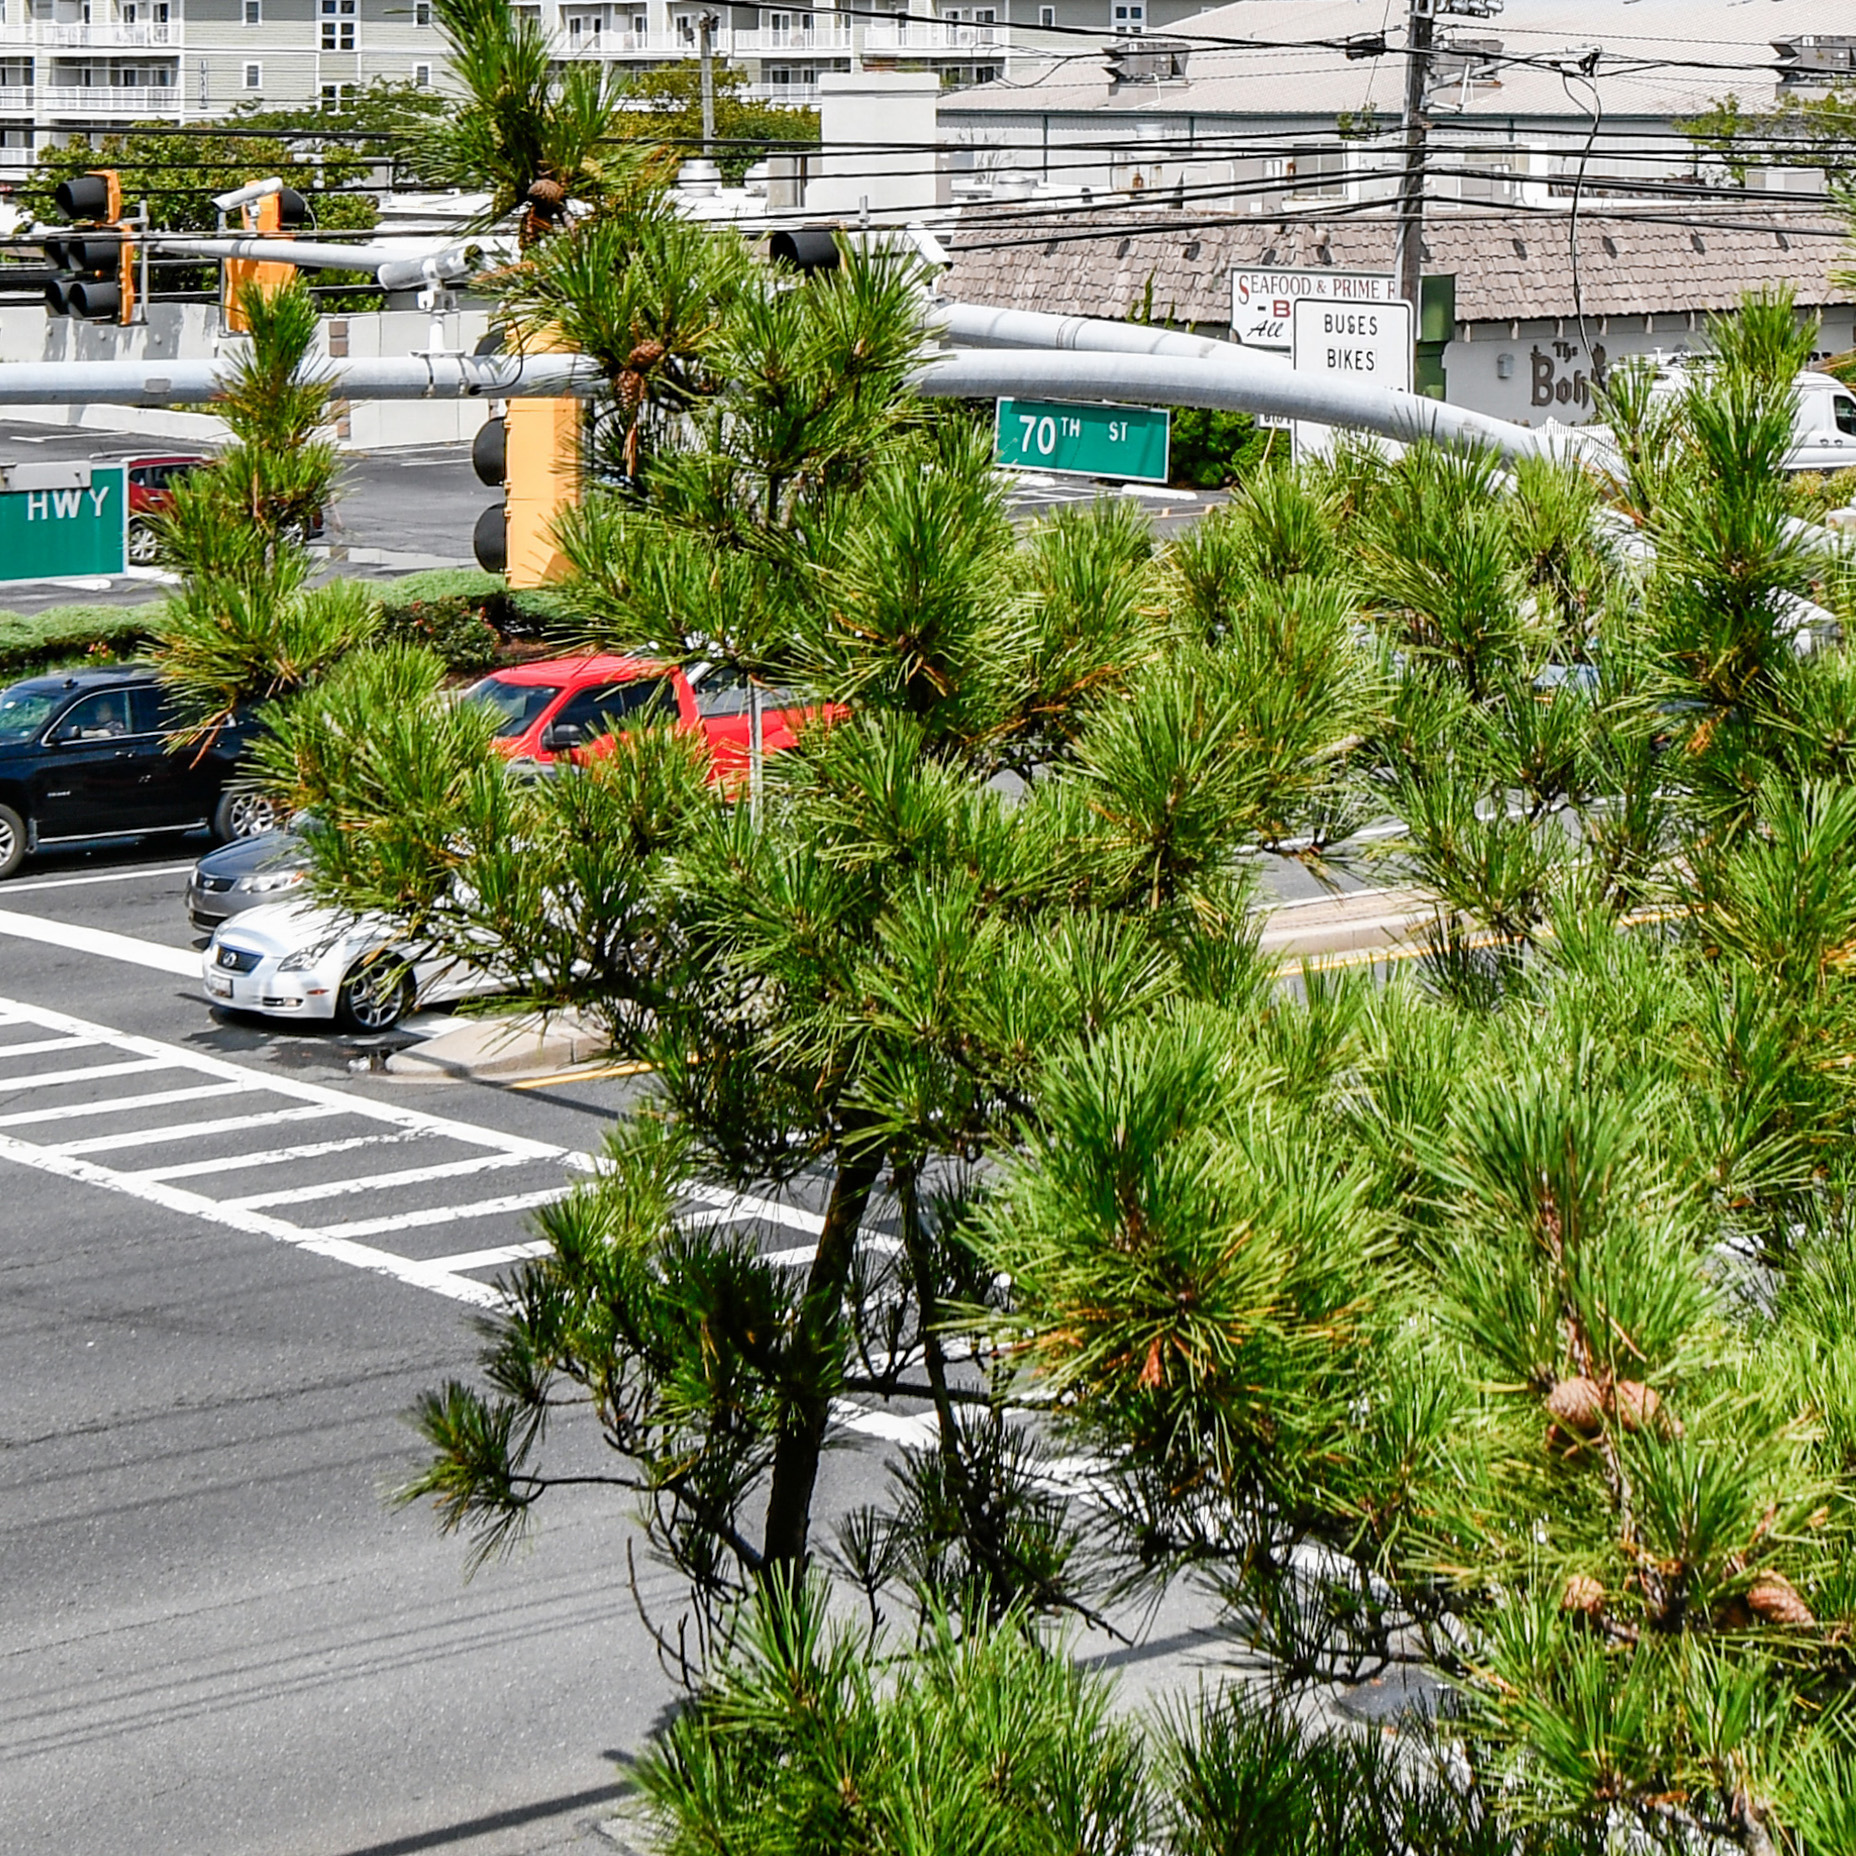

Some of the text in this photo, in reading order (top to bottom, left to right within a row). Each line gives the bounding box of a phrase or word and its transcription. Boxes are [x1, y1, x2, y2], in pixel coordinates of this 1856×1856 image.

[1316, 282, 1326, 294] &
[1333, 278, 1380, 300] PRIME
[1327, 348, 1375, 371] BIKES
[1552, 341, 1578, 363] The
[1108, 421, 1128, 442] ST
[26, 485, 110, 521] HWY
